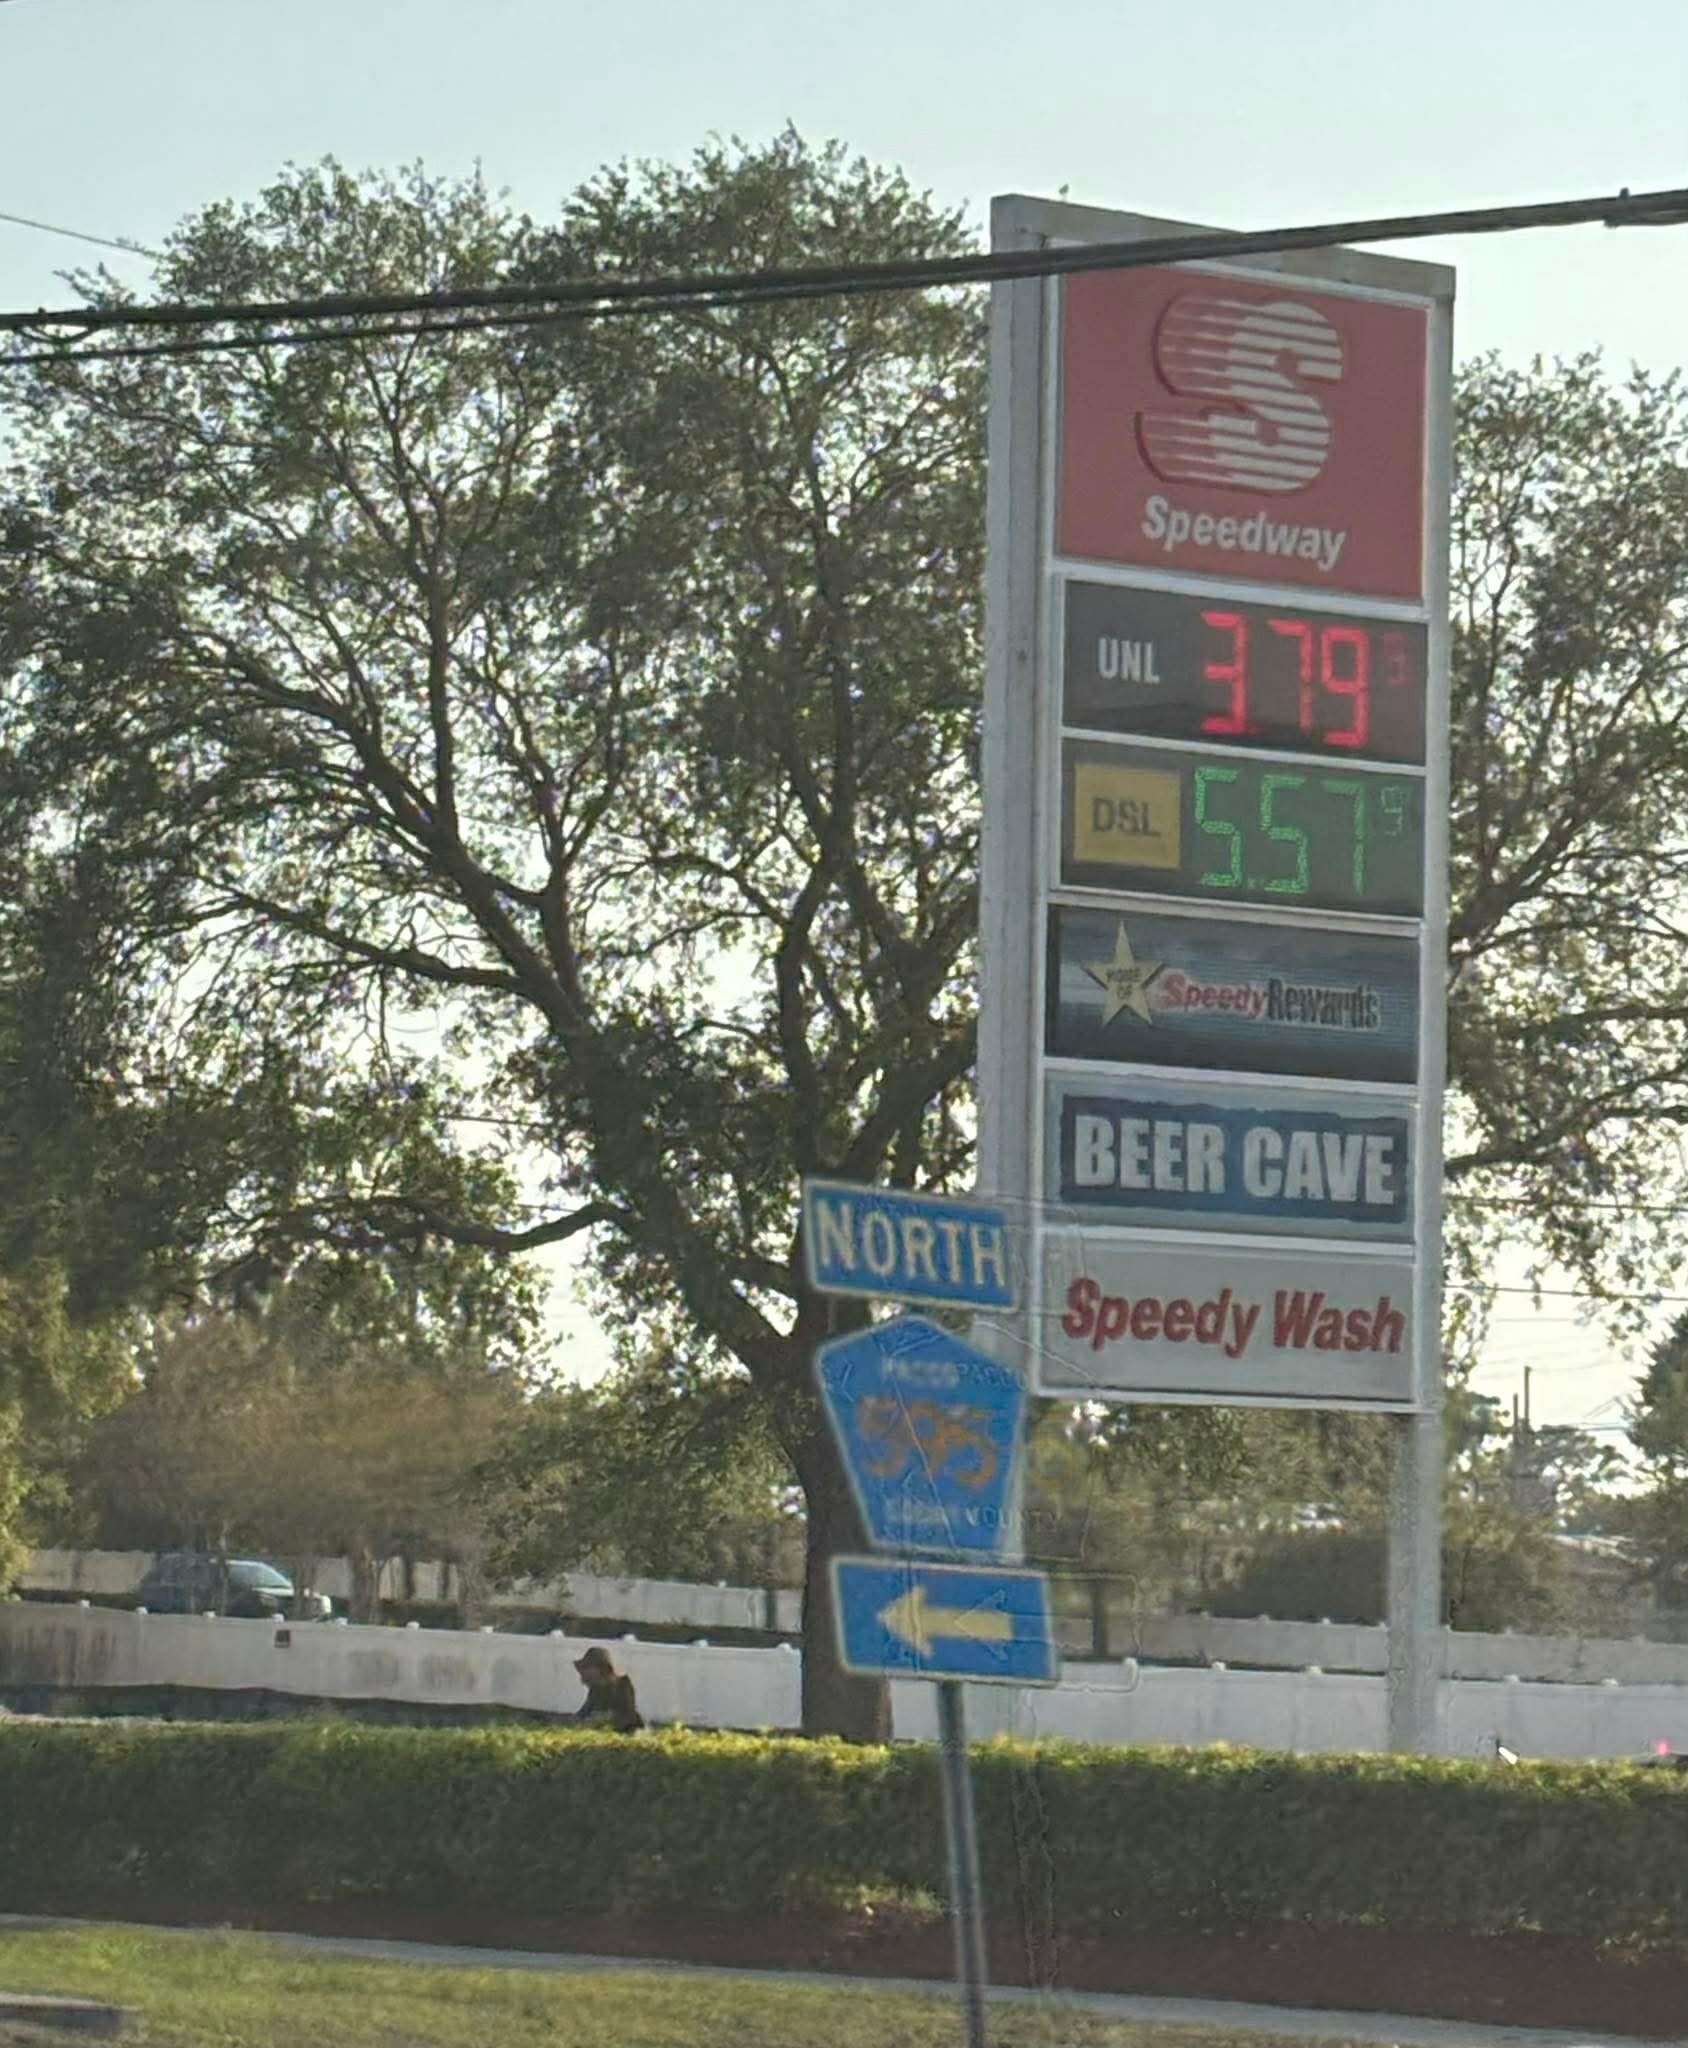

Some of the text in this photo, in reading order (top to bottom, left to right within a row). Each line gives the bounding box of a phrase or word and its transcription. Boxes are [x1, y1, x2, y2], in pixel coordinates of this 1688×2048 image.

[1141, 495, 1347, 572] Speedway
[1099, 638, 1161, 684] UNL
[1091, 798, 1161, 838] DSL
[1075, 1115, 1395, 1205] BEER CAVE
[816, 1199, 1005, 1287] NORTH
[1061, 1277, 1405, 1358] Speedy Wash
